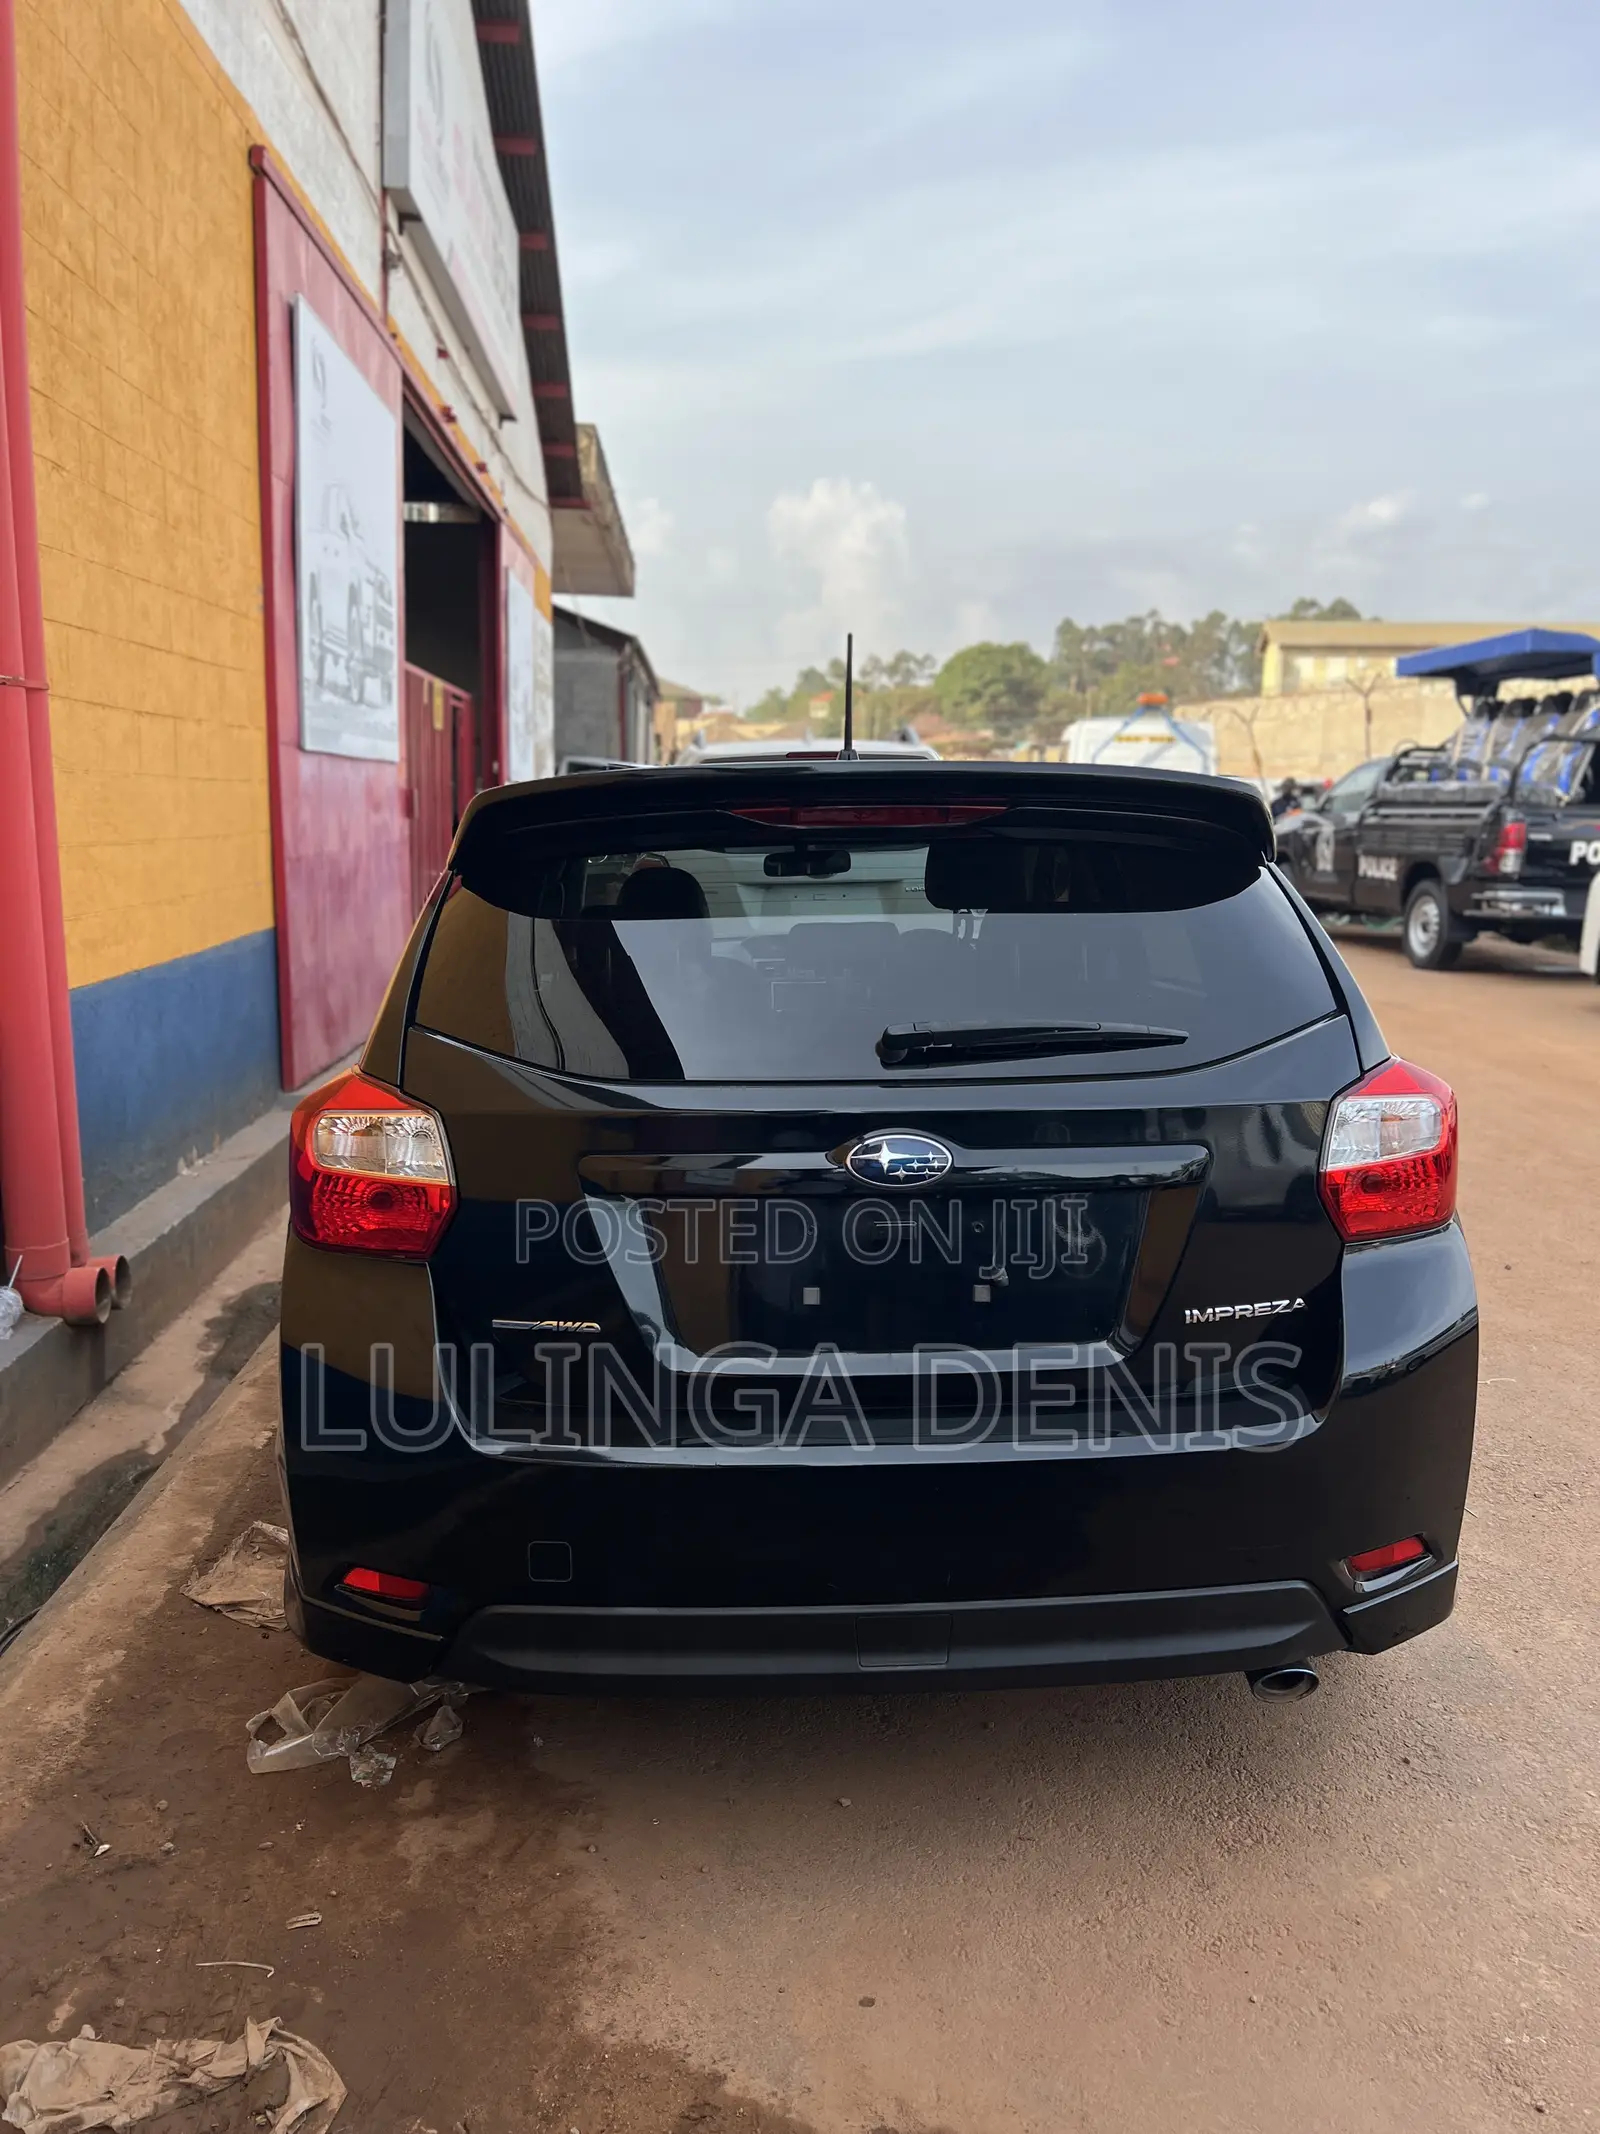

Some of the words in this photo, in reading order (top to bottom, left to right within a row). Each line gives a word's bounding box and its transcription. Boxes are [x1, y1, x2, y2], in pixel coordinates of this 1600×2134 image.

[1358, 854, 1398, 881] POLICE
[1184, 1298, 1307, 1324] IMPREZA
[531, 1320, 601, 1333] AWD
